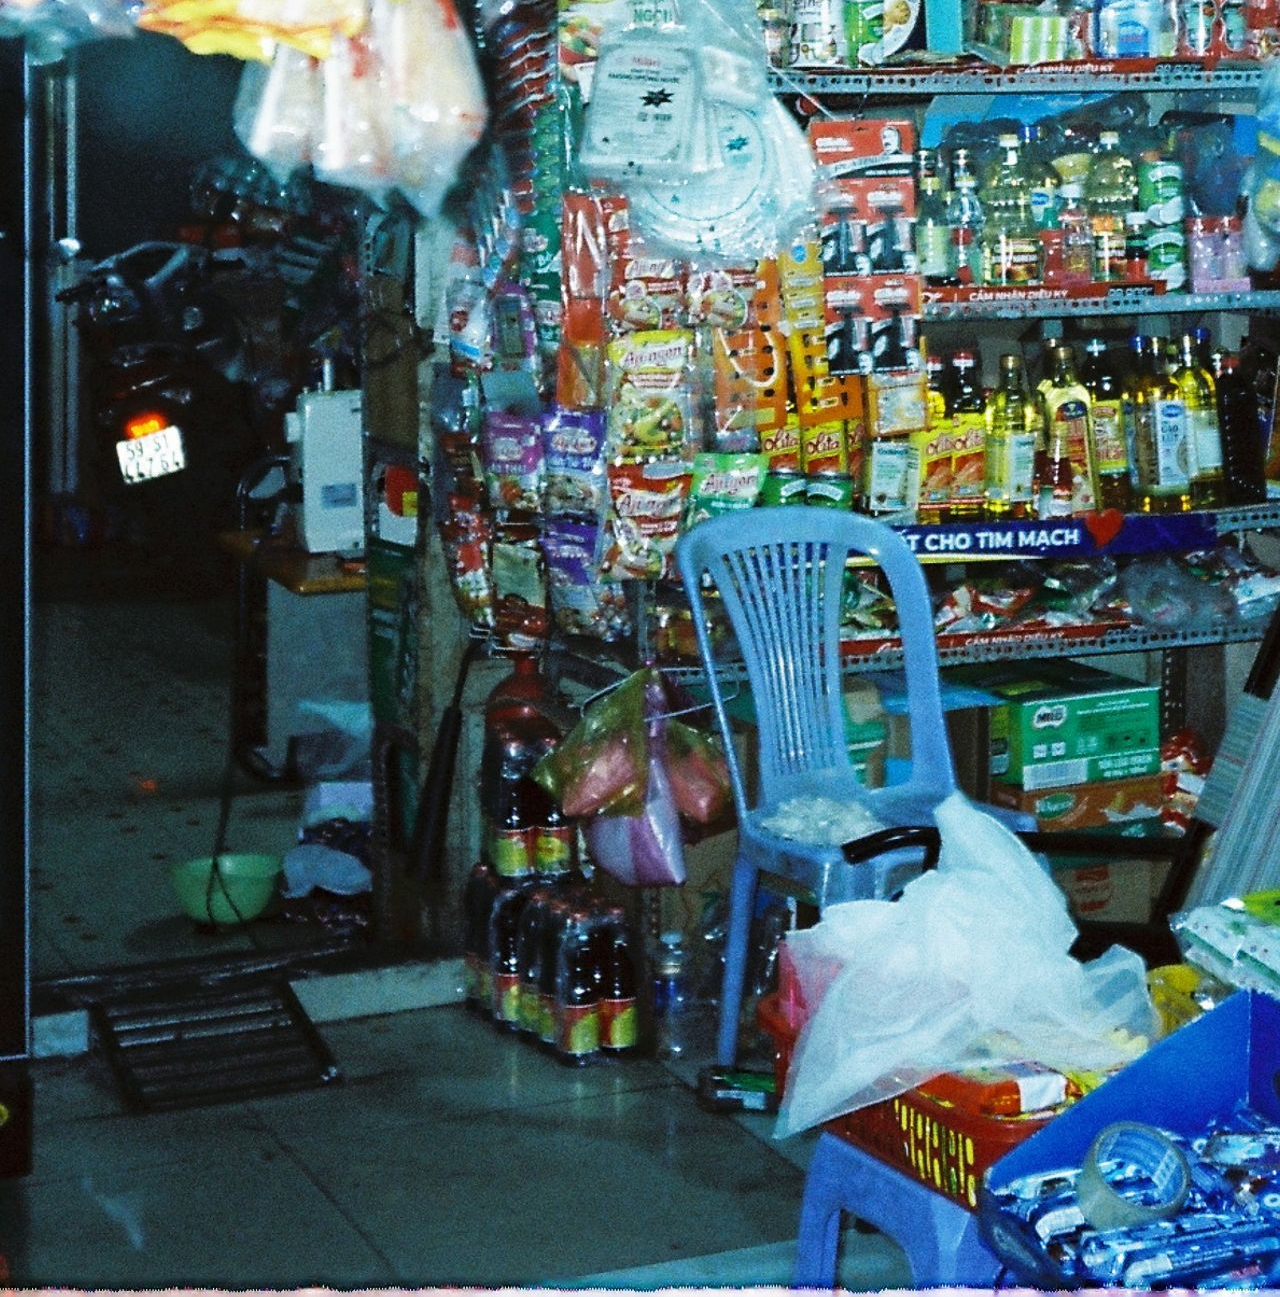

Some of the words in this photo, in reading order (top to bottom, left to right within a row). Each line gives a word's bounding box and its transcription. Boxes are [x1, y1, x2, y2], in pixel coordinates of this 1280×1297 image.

[925, 532, 971, 551] CHO
[975, 531, 1015, 549] TIM
[1018, 528, 1081, 552] MẠCH
